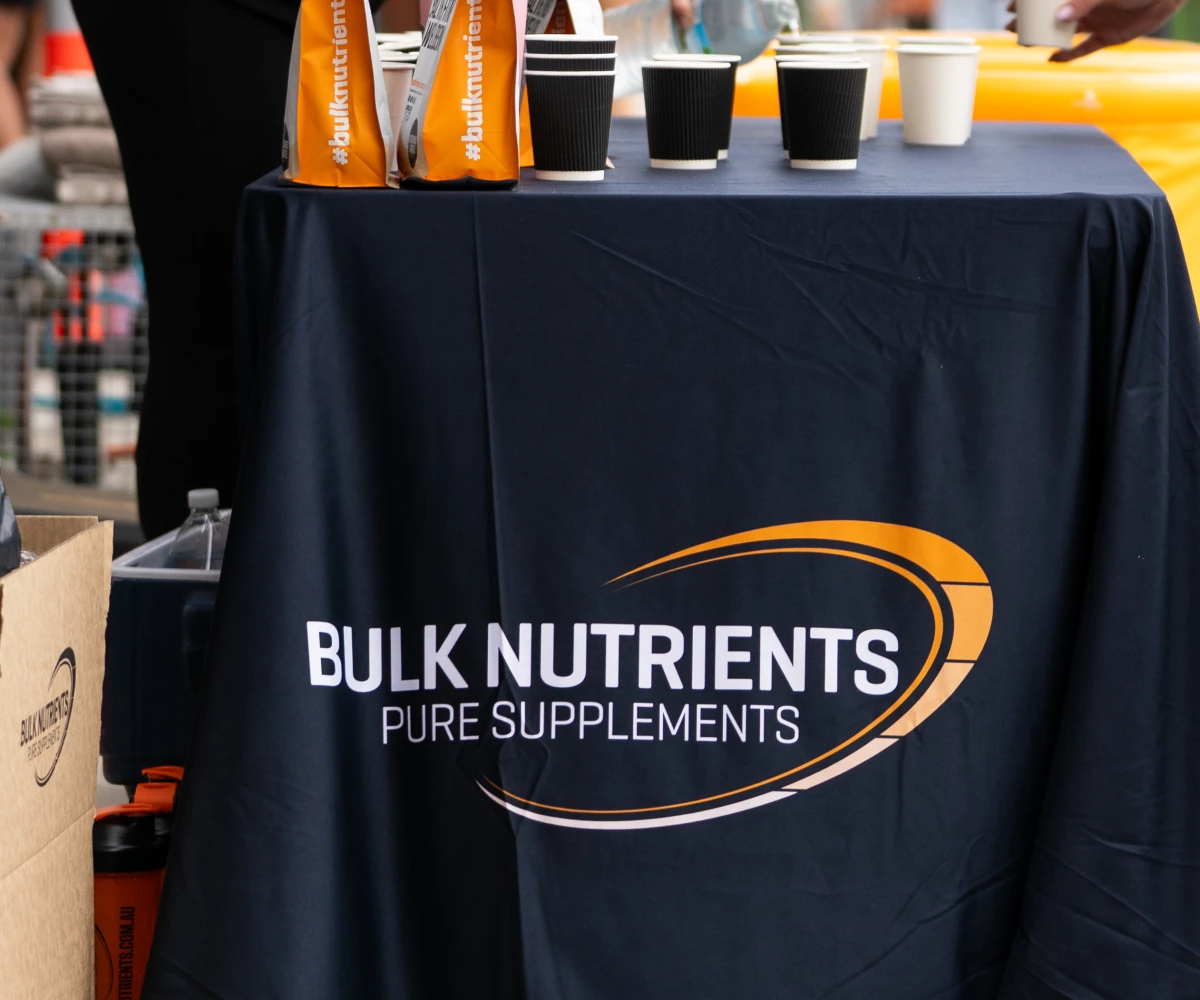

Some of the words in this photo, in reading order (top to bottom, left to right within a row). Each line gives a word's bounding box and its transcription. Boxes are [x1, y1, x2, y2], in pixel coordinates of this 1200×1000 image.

[307, 620, 468, 693] BULK
[487, 622, 900, 696] NUTRIENTS
[20, 711, 38, 747] BULK
[38, 689, 69, 738] NUTRIENTS
[382, 703, 480, 745] PURE
[491, 701, 801, 745] SUPPLEMENTS
